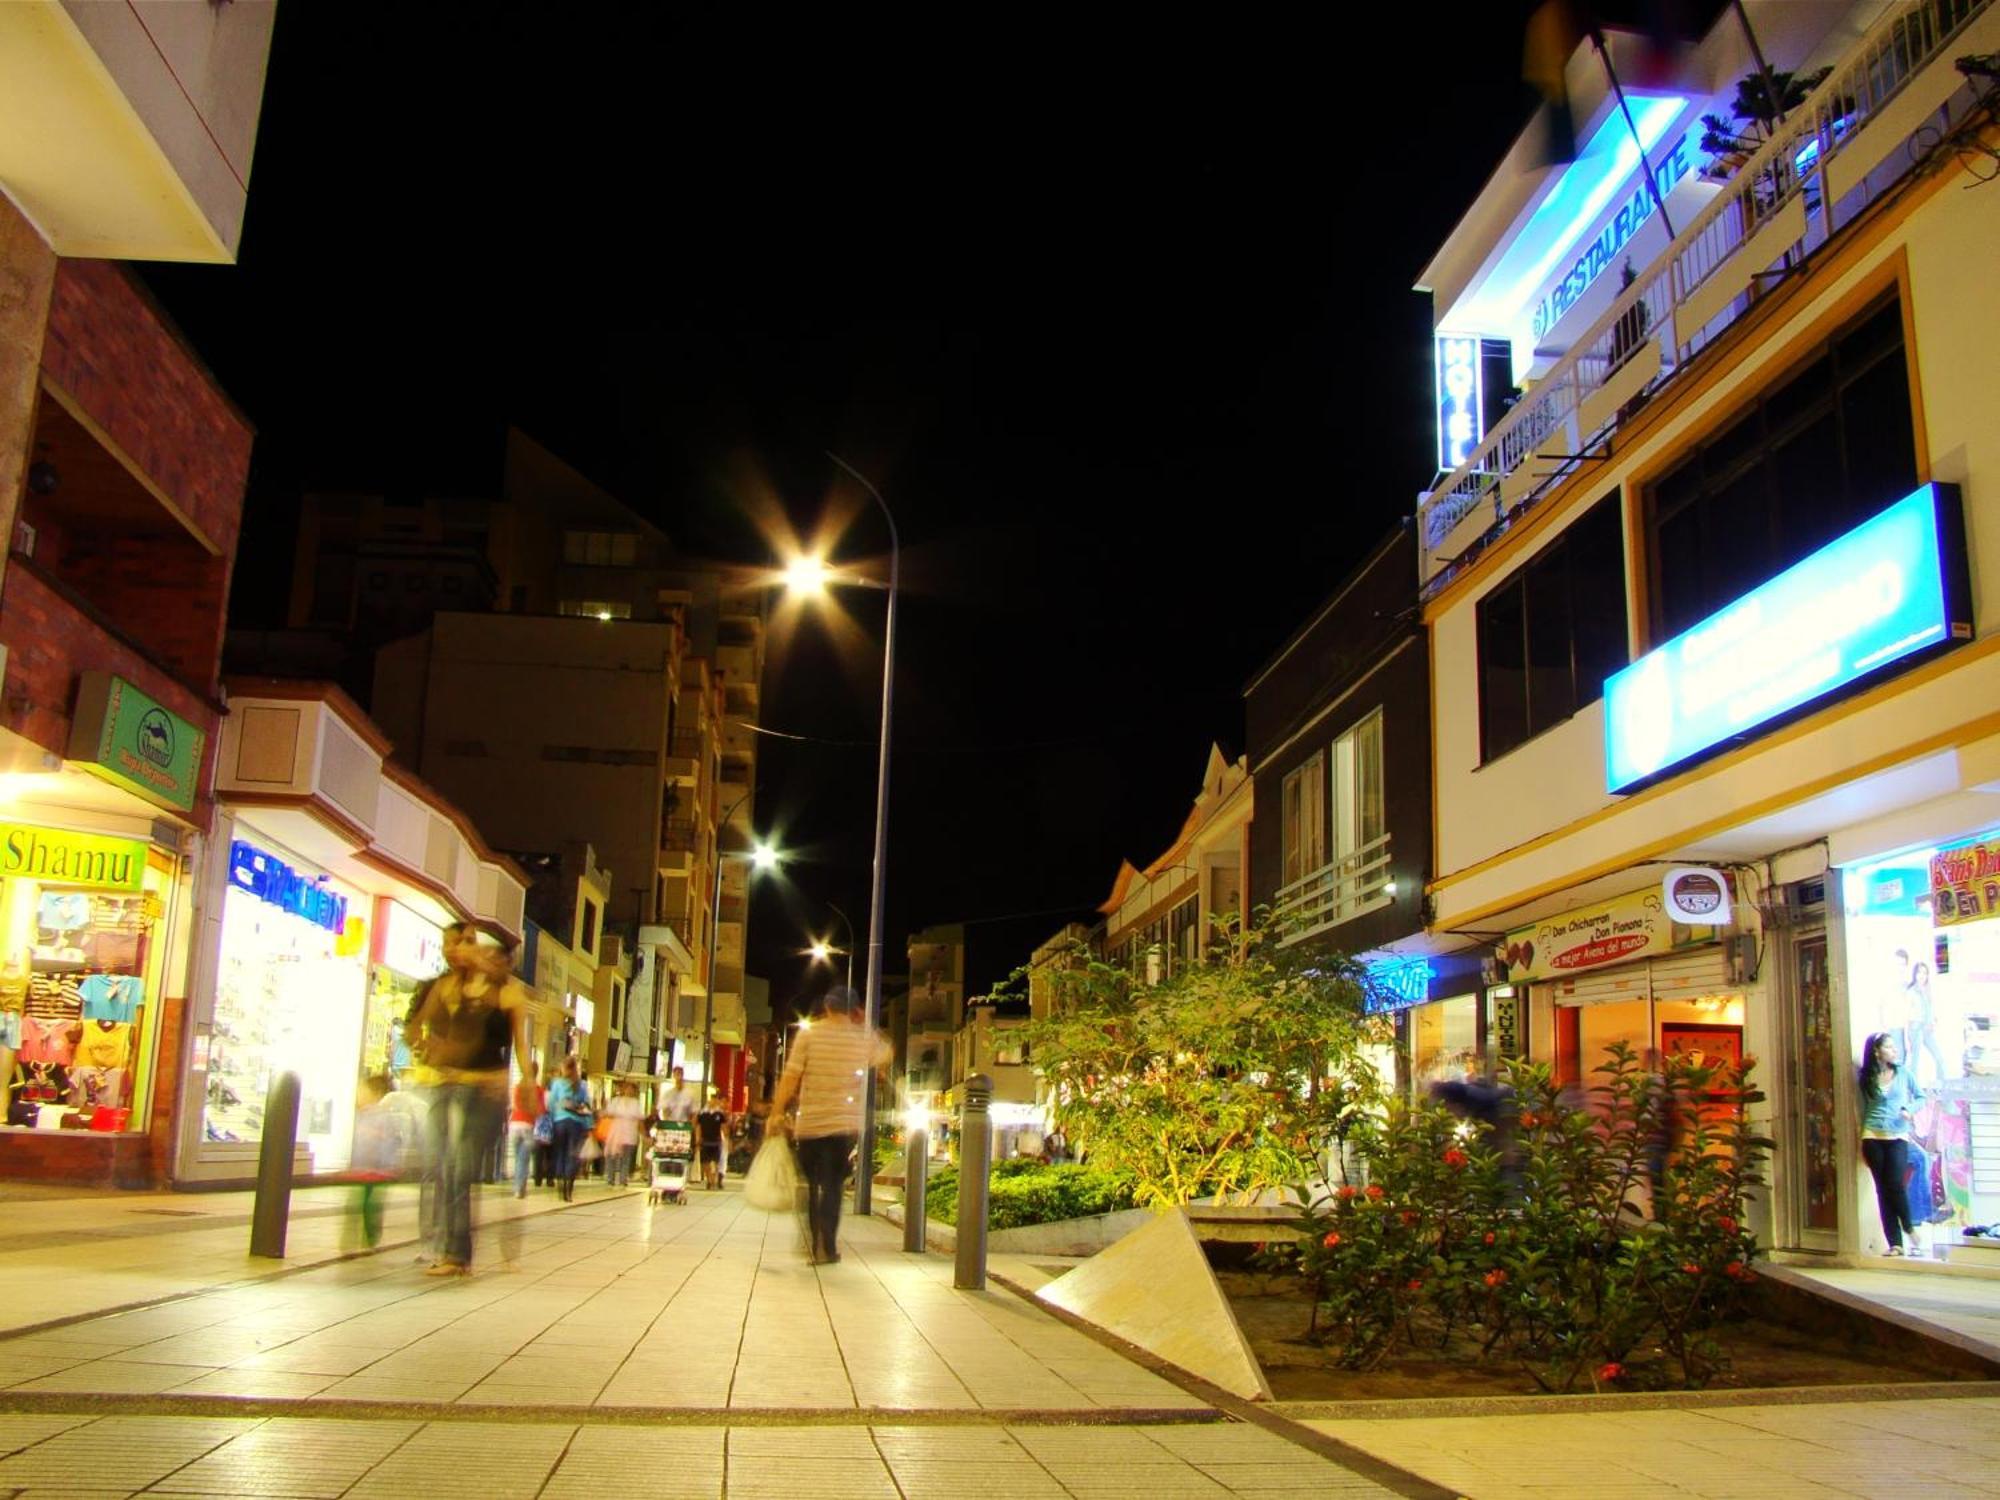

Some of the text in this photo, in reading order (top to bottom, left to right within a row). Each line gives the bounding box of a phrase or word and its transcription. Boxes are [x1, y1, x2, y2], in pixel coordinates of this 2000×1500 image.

[1551, 134, 1690, 325] RESTAURANTE
[1445, 339, 1474, 467] HOTEL
[4, 830, 133, 883] Shamu
